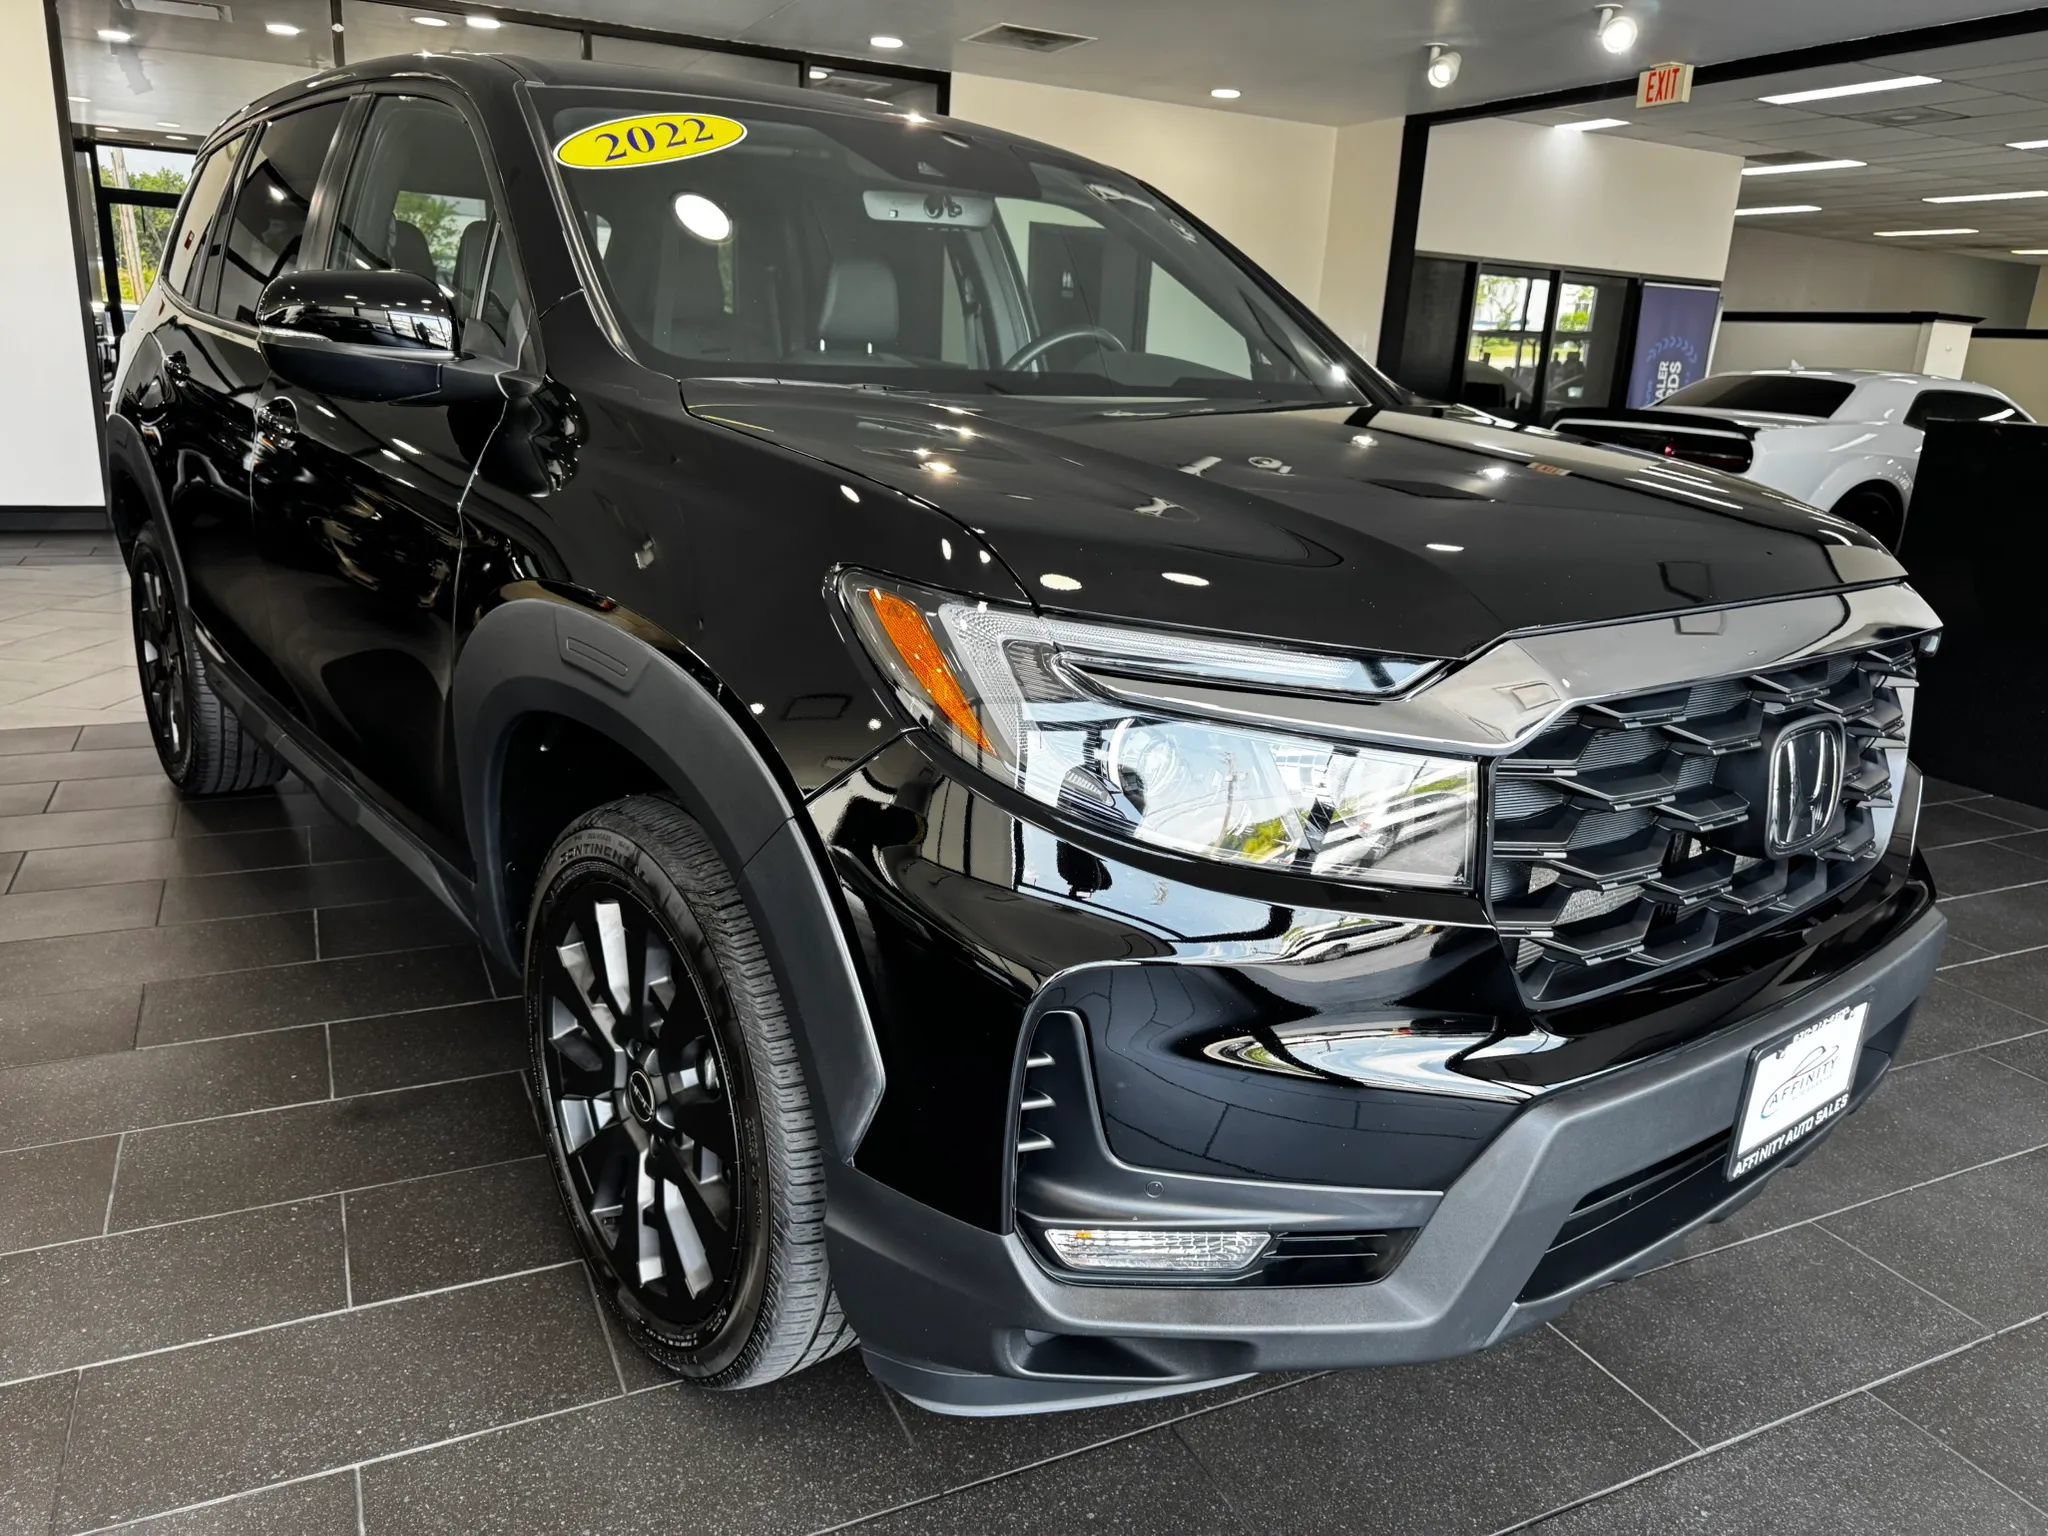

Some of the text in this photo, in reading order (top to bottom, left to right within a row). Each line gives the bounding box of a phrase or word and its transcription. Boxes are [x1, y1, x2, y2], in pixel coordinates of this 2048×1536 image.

[1646, 68, 1681, 103] EXIT
[595, 118, 714, 162] 2022
[1769, 1056, 1839, 1108] AFFINITY
[1733, 1094, 1849, 1178] AFFINITY AUTO SALES
